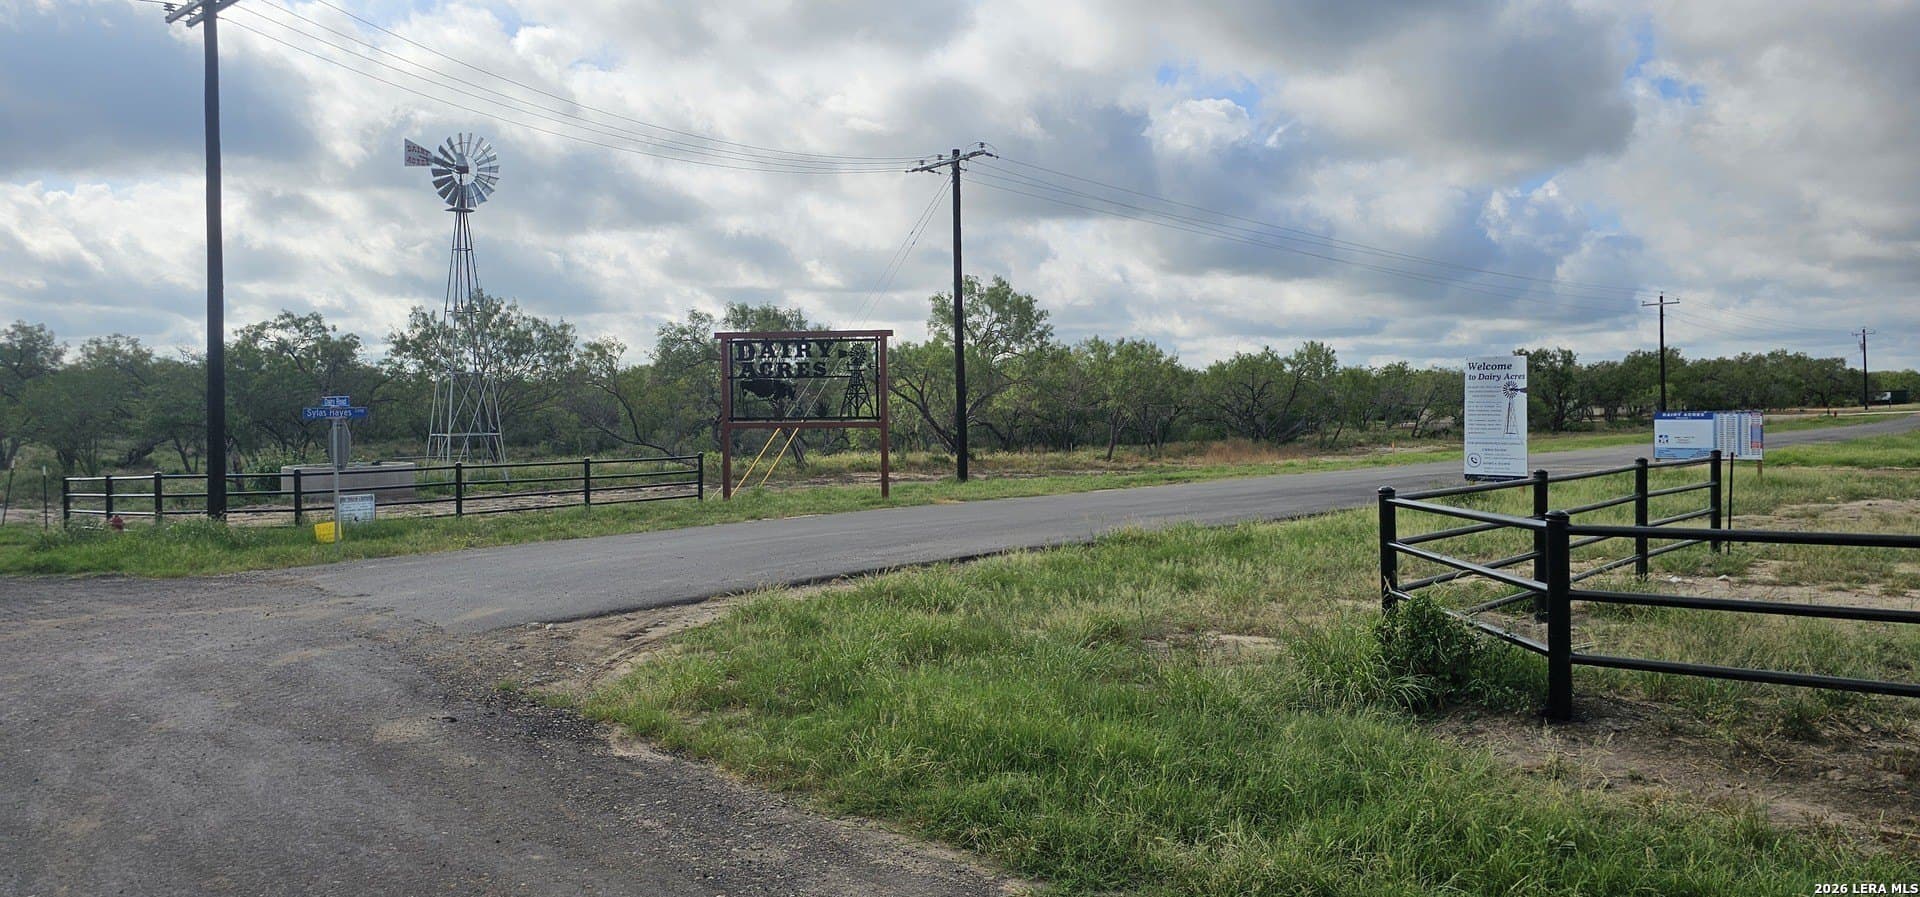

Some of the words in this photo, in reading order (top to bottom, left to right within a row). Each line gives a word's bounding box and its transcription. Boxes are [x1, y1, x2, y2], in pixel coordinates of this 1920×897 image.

[734, 340, 834, 360] DAIRY
[740, 360, 827, 378] ACRES
[1468, 362, 1513, 371] Welcome
[1478, 373, 1501, 382] Dairy
[306, 408, 327, 419] Sylas
[329, 408, 352, 418] Hayes
